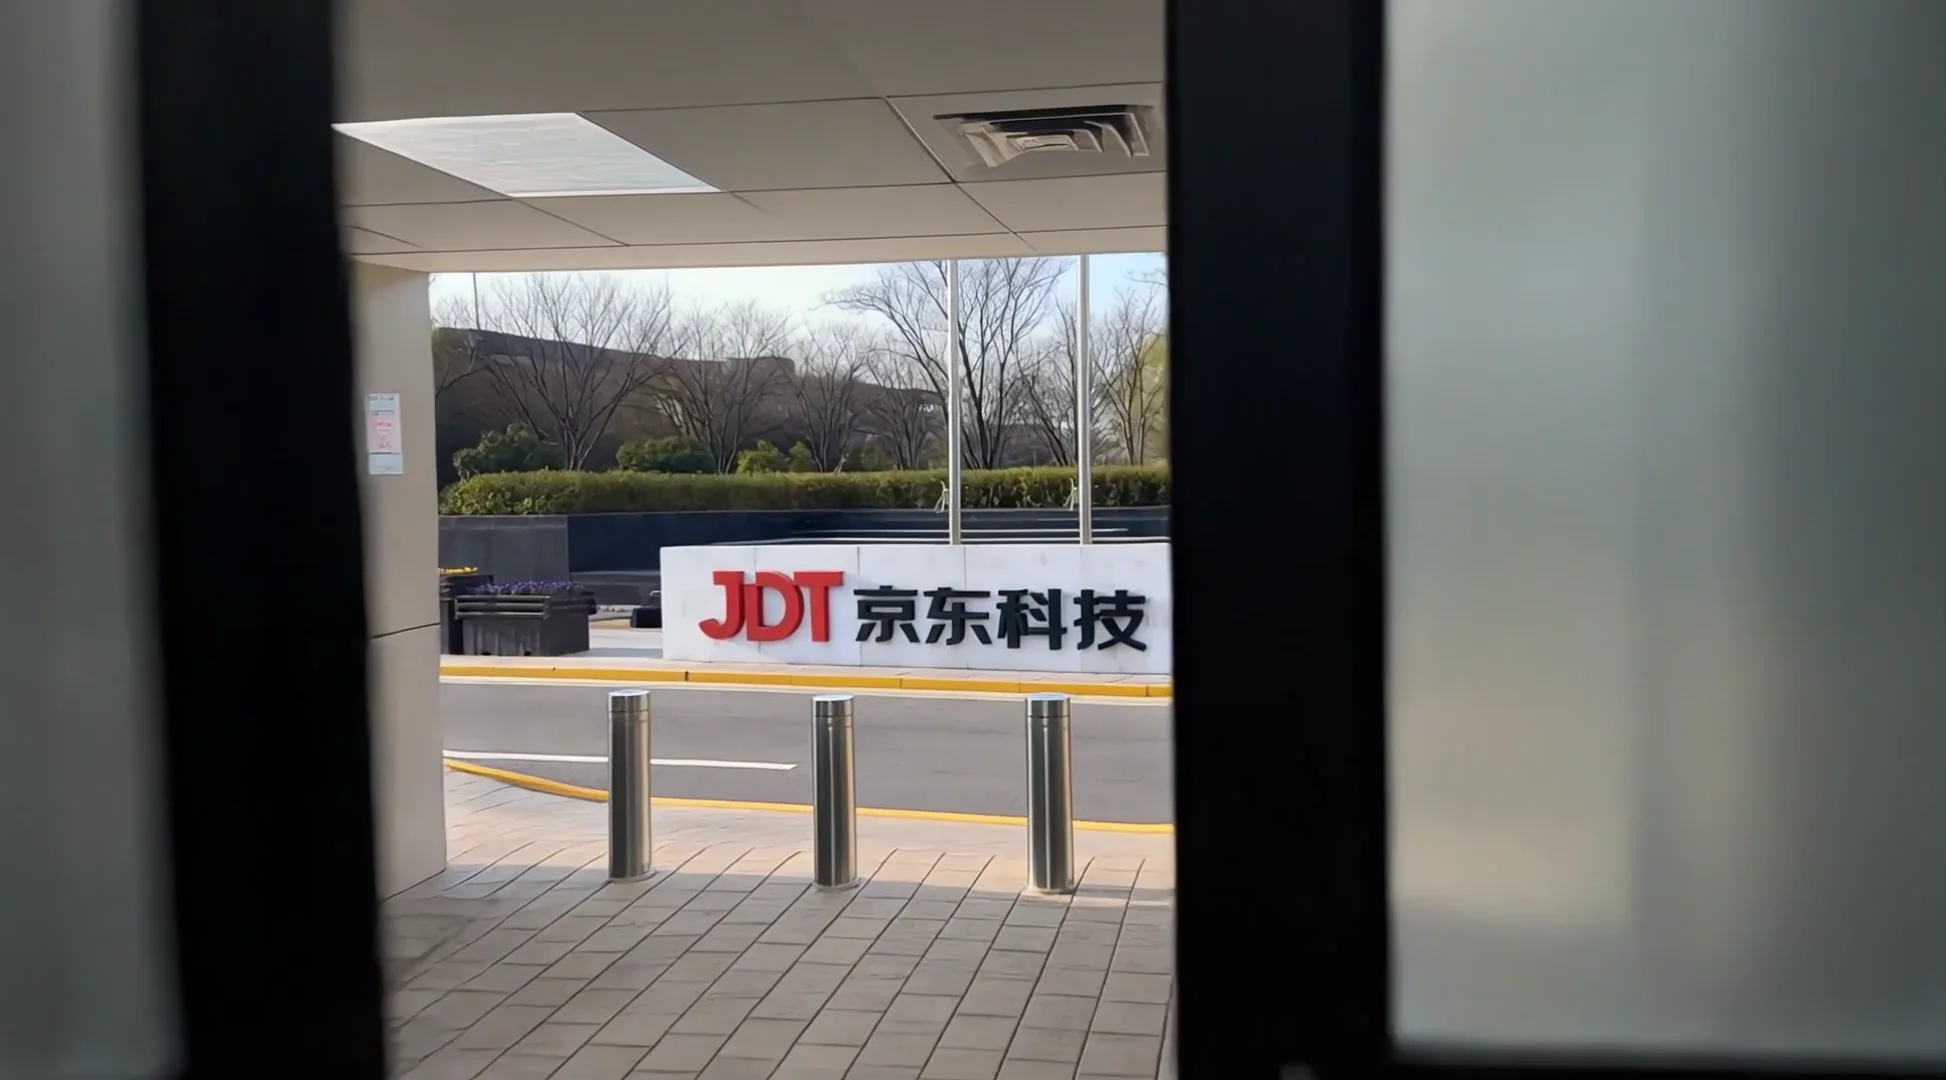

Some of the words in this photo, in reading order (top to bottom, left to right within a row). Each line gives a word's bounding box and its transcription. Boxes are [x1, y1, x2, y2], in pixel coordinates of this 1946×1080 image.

[699, 571, 844, 642] JDT
[853, 585, 1147, 652] 京东科技
